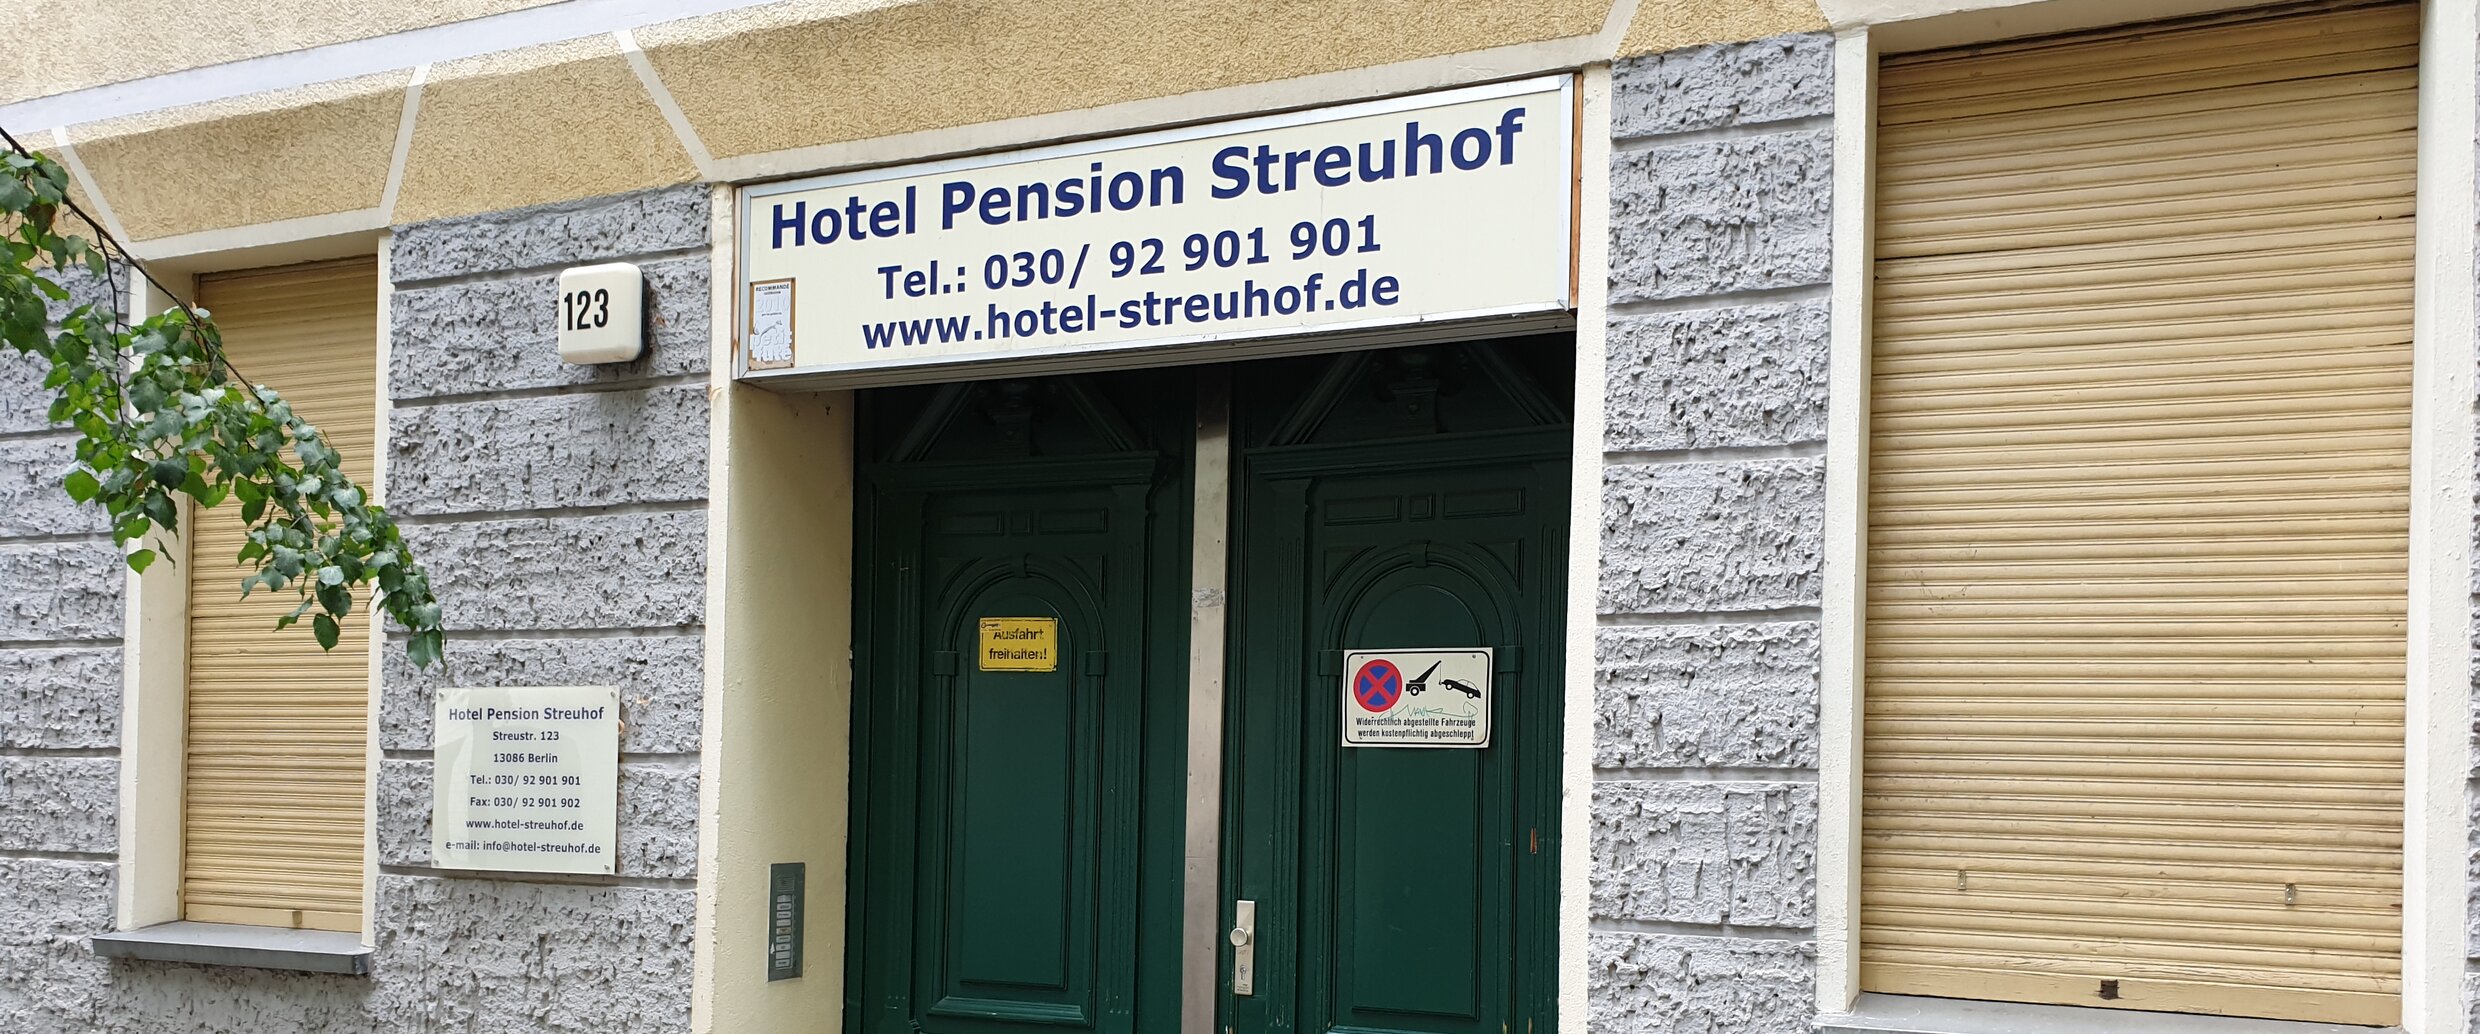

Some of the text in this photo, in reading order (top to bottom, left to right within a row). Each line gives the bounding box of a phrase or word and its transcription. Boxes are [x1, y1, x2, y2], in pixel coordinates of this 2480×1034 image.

[771, 107, 1526, 250] Hotel Pension Streuhof
[878, 214, 1381, 301] Tel.: 030/ 92 901 901
[564, 288, 609, 331] 123
[861, 268, 1400, 350] www.hotel-streuhof.de
[993, 628, 1044, 640] Ausfahrt
[989, 648, 1047, 660] freihalten!
[449, 707, 604, 721] Hotel Pension Streuhof
[1356, 717, 1476, 728] Widerrechtlich abgestellte Fahrzeuge
[493, 731, 559, 741] Streustr. 123
[1358, 729, 1380, 737] werden
[1381, 729, 1429, 739] kostenpflichtig
[493, 753, 558, 763] 13086 Berlin
[470, 775, 581, 786] Tel.: 030/ 92 901 901
[470, 797, 580, 808] Fax: 030/ 92 901 902
[466, 819, 584, 831] www.hotel-streuhof.de
[445, 840, 601, 854] e-mail: info@hotel-streuhof.de
